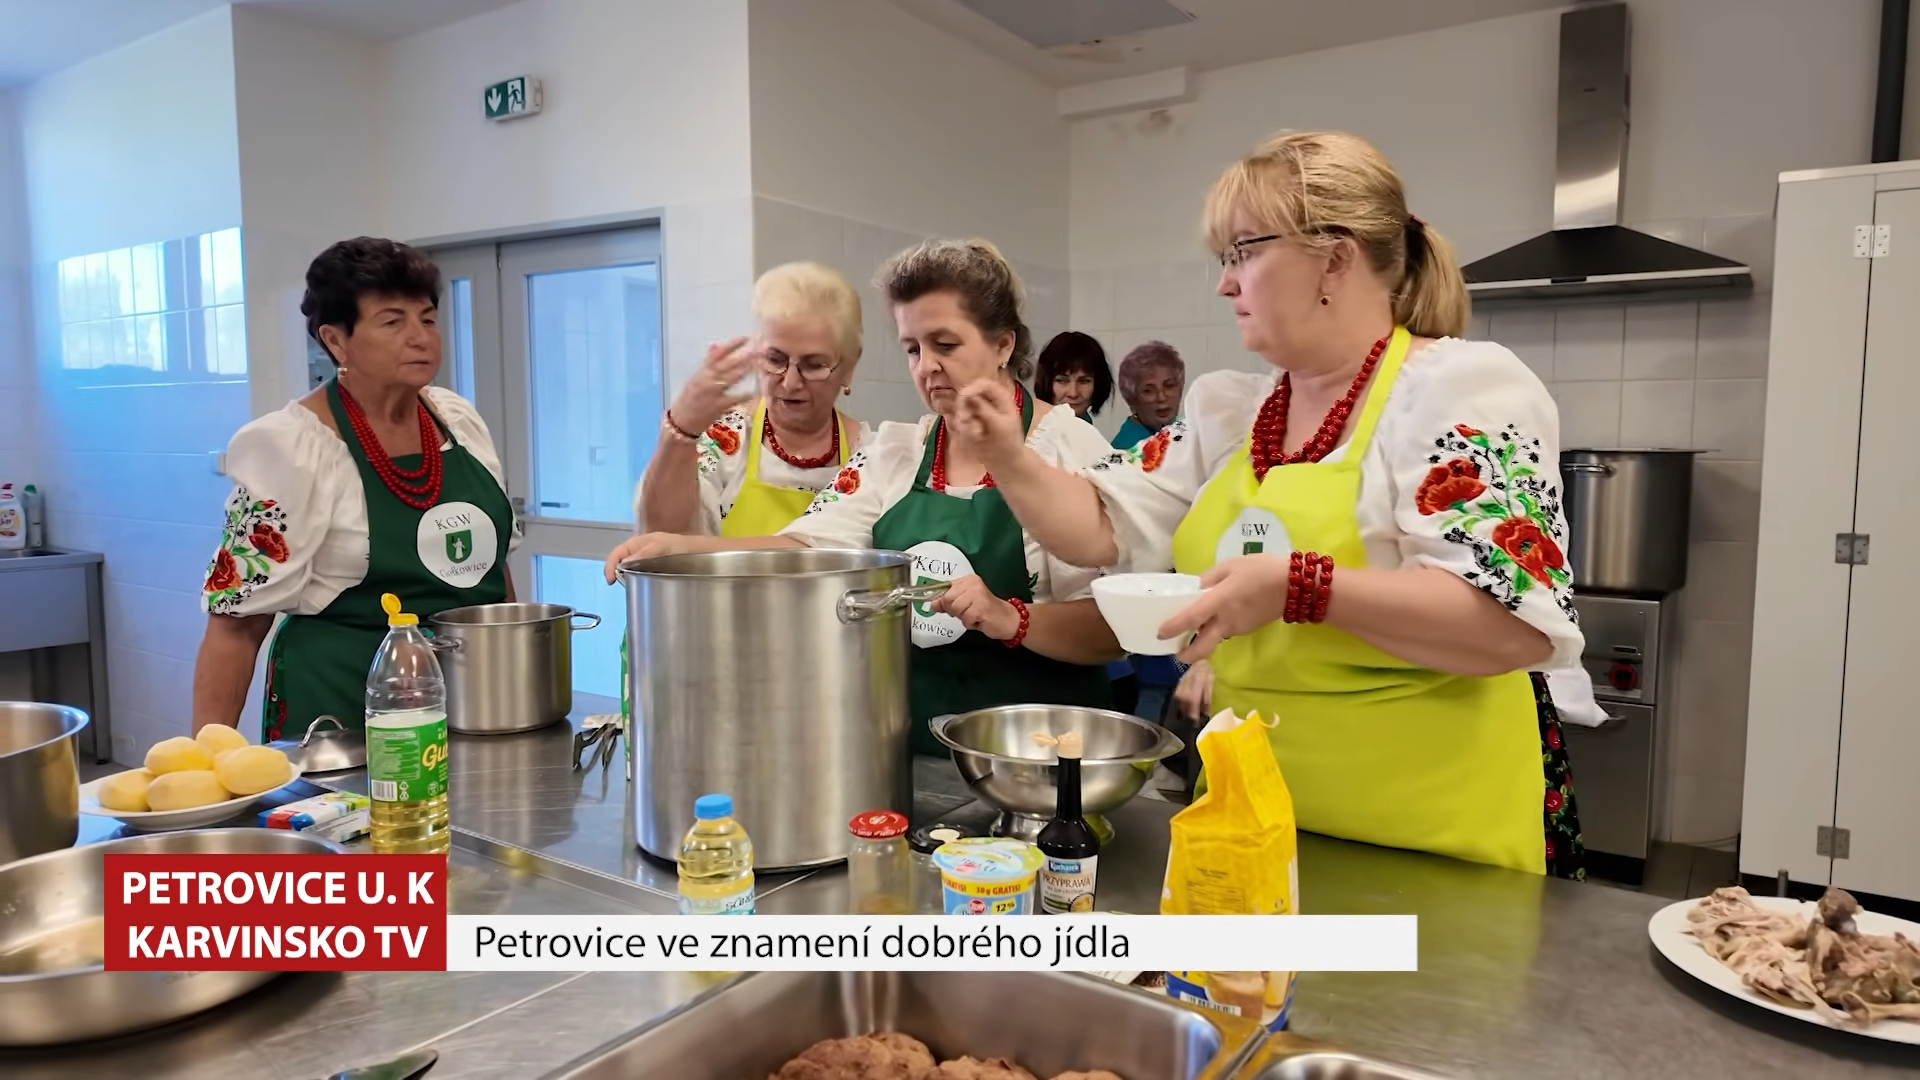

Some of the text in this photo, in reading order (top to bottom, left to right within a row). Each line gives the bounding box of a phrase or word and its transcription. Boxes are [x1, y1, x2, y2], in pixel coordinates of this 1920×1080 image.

[434, 512, 471, 530] KGW
[915, 555, 958, 576] KGW
[912, 616, 954, 638] kowice
[1042, 871, 1092, 888] PRZYPRAWA
[992, 884, 1021, 896] GRATIS!
